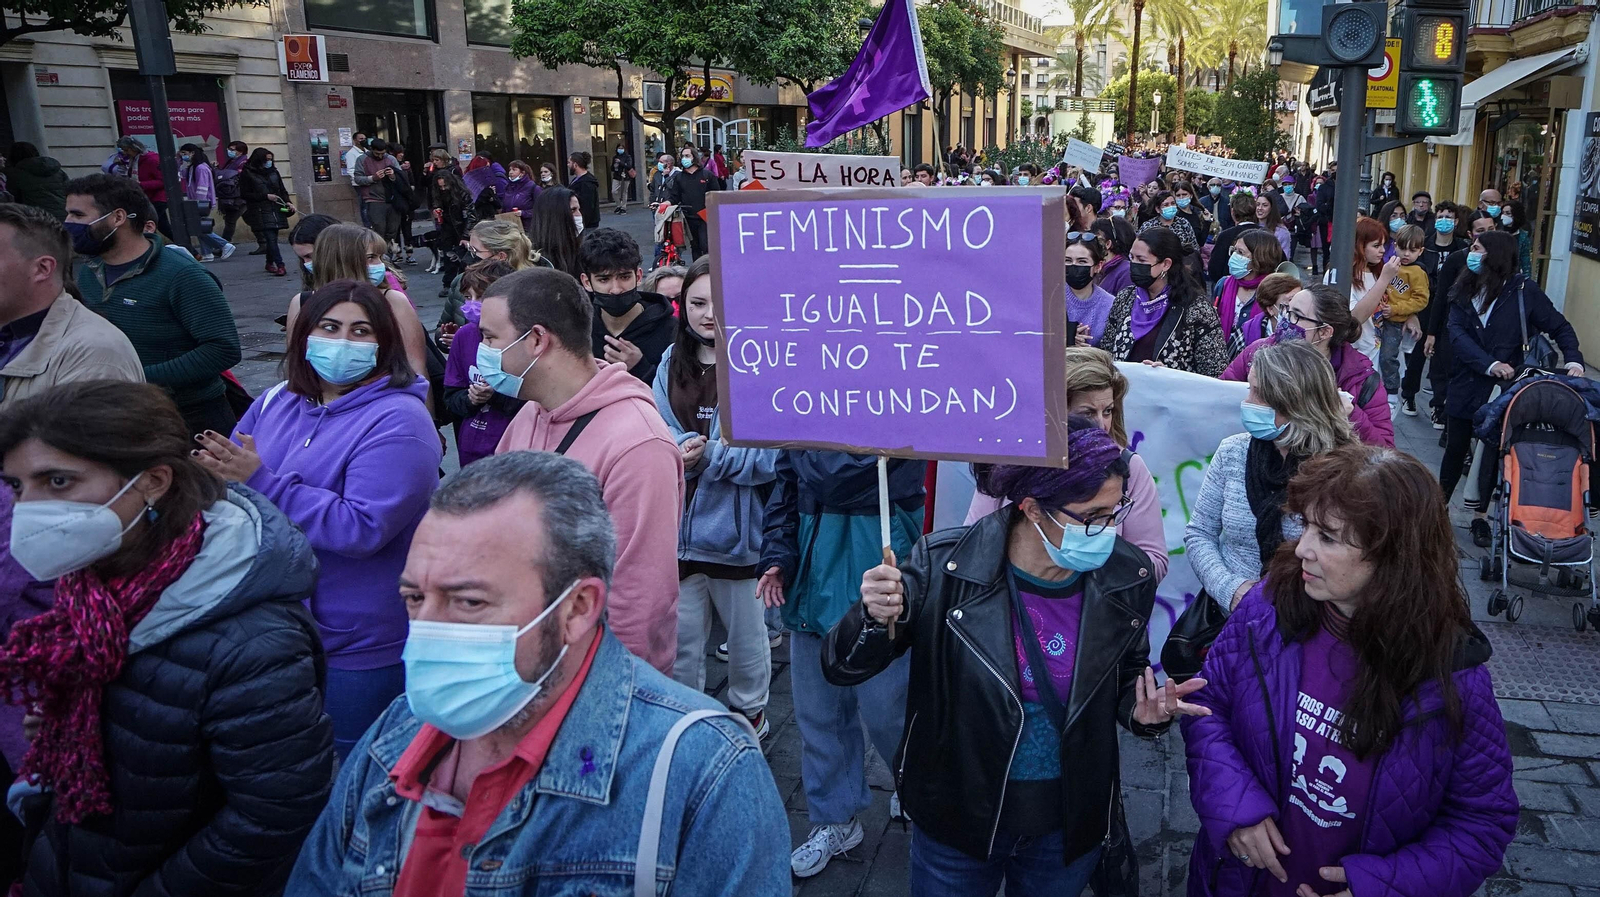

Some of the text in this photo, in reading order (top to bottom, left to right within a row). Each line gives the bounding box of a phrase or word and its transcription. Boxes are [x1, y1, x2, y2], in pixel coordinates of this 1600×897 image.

[1435, 23, 1453, 58] 8
[290, 70, 319, 79] FLAMENCO
[1176, 150, 1202, 161] ANTES
[1205, 157, 1215, 165] DE
[1221, 160, 1235, 168] SER
[1177, 159, 1259, 180] SOMOS SERES HUMANOS
[750, 159, 895, 188] ES LA HORA
[738, 205, 994, 254] FEMINISMO
[780, 291, 992, 326] IGUALDAD
[727, 329, 940, 375] (QUE NO TE
[1297, 691, 1325, 716] TROS
[1296, 710, 1317, 731] ASO
